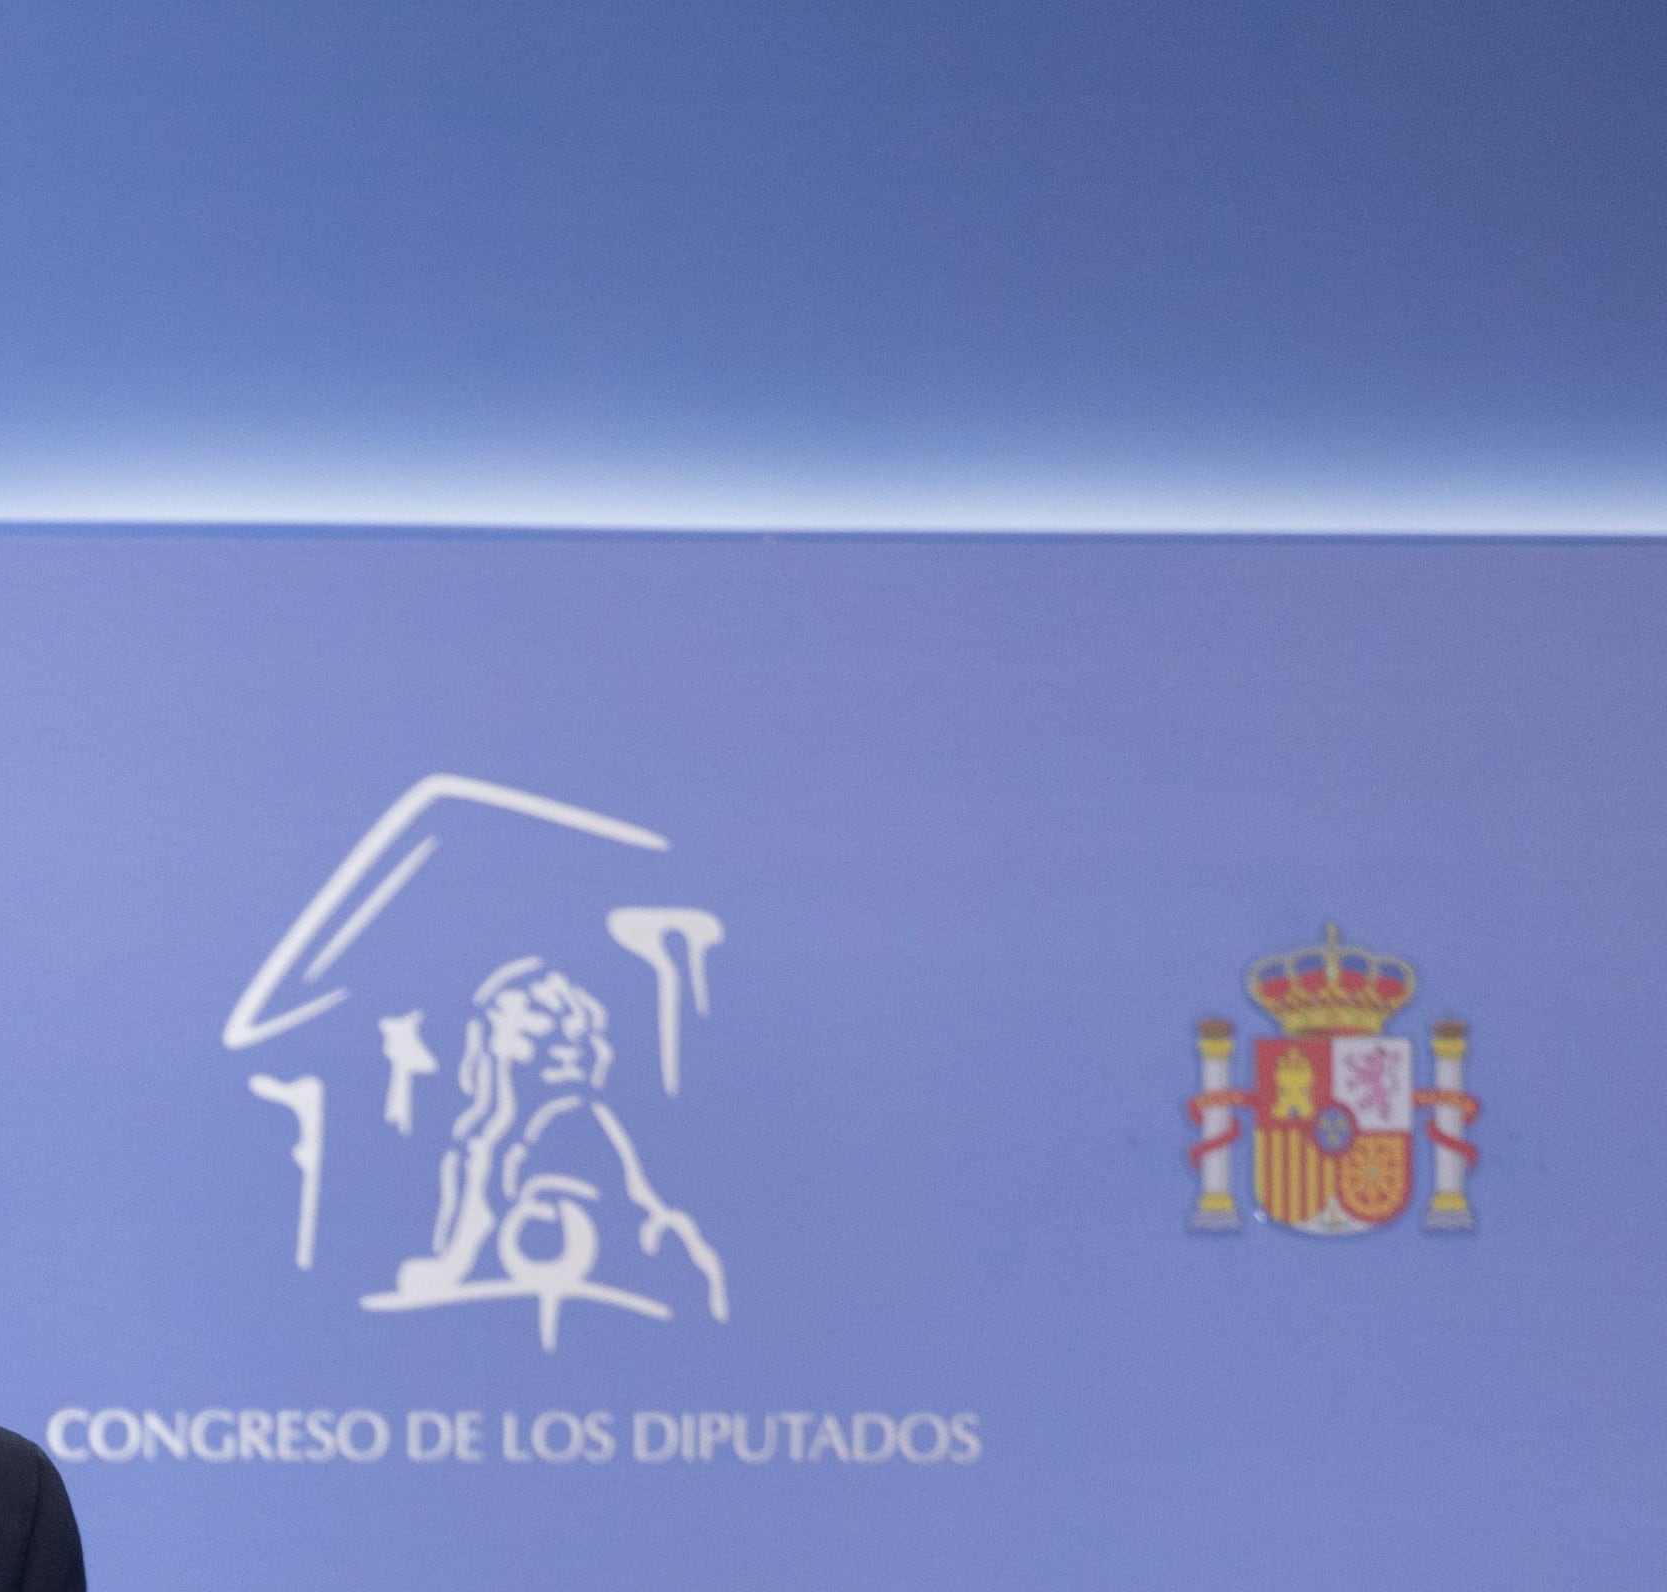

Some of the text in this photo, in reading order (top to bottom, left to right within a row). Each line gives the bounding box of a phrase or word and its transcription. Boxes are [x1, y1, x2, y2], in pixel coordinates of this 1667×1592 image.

[46, 1406, 982, 1464] CONGRESO DE LOS DIPUTADOS
